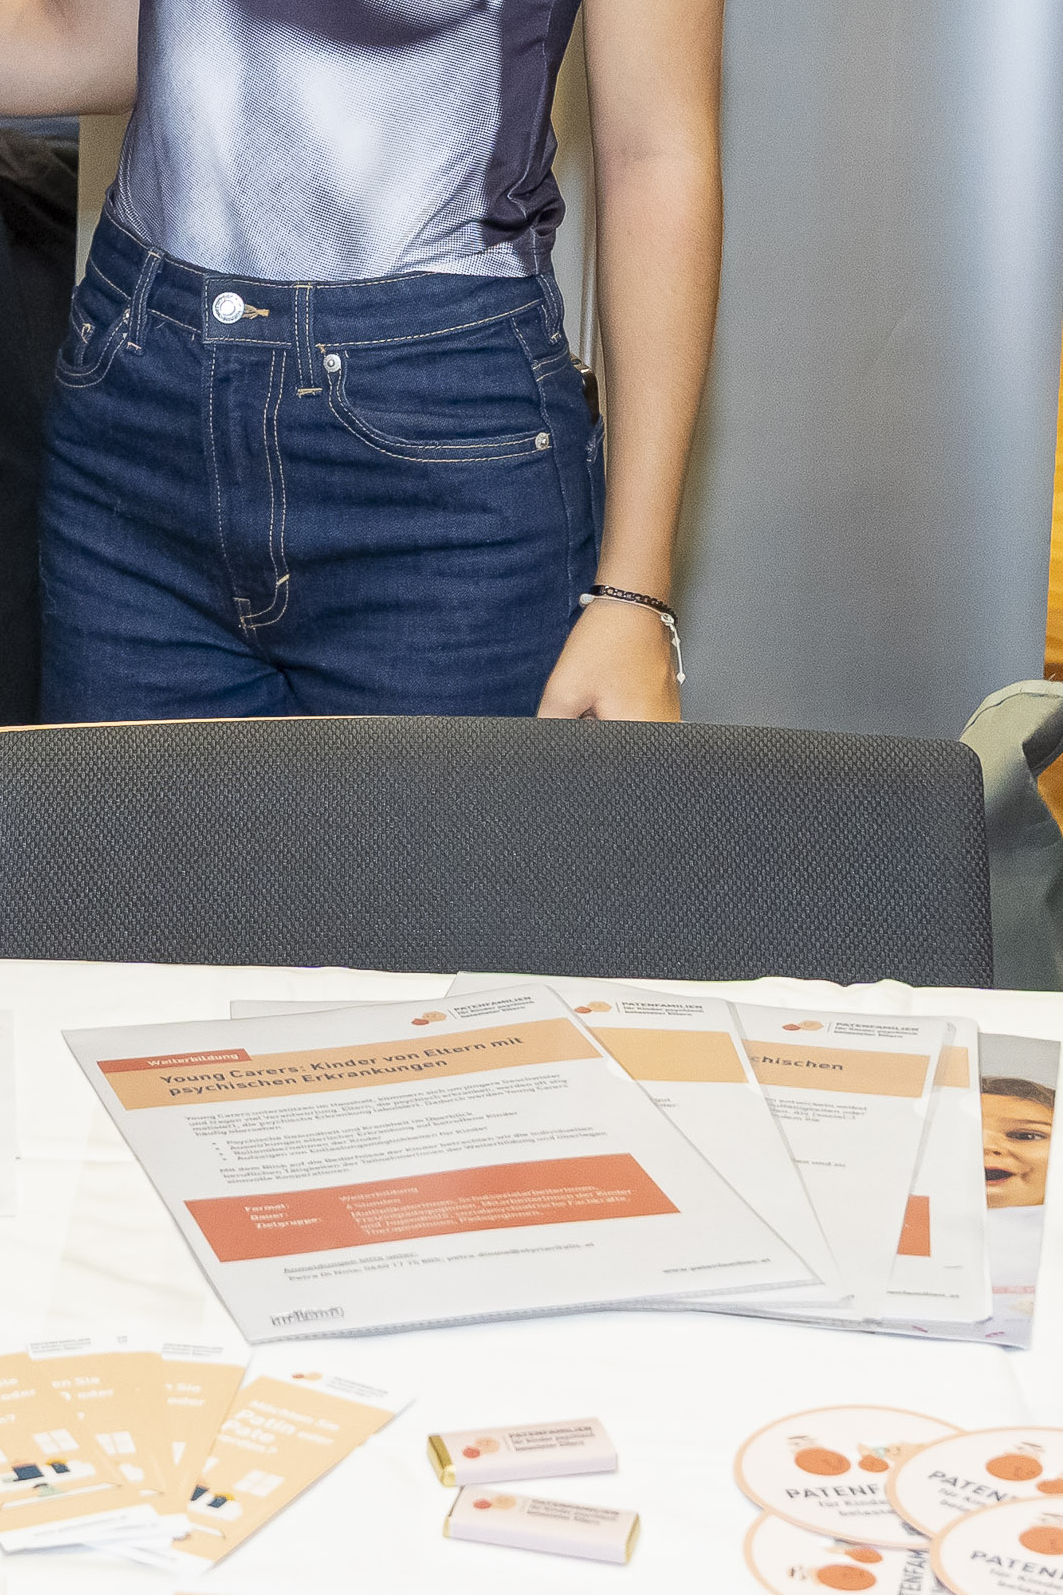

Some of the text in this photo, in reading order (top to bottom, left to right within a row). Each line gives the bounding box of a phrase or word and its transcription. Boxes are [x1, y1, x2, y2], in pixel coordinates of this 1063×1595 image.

[147, 1054, 238, 1066] Weiterbildung
[160, 1037, 523, 1083] Young Carers: Kinder von Eltern mit
[169, 1060, 447, 1096] psychischen Erkrankungen
[0, 1388, 37, 1402] oder
[784, 1483, 881, 1500] PATENF
[928, 1469, 1008, 1502] PATEN
